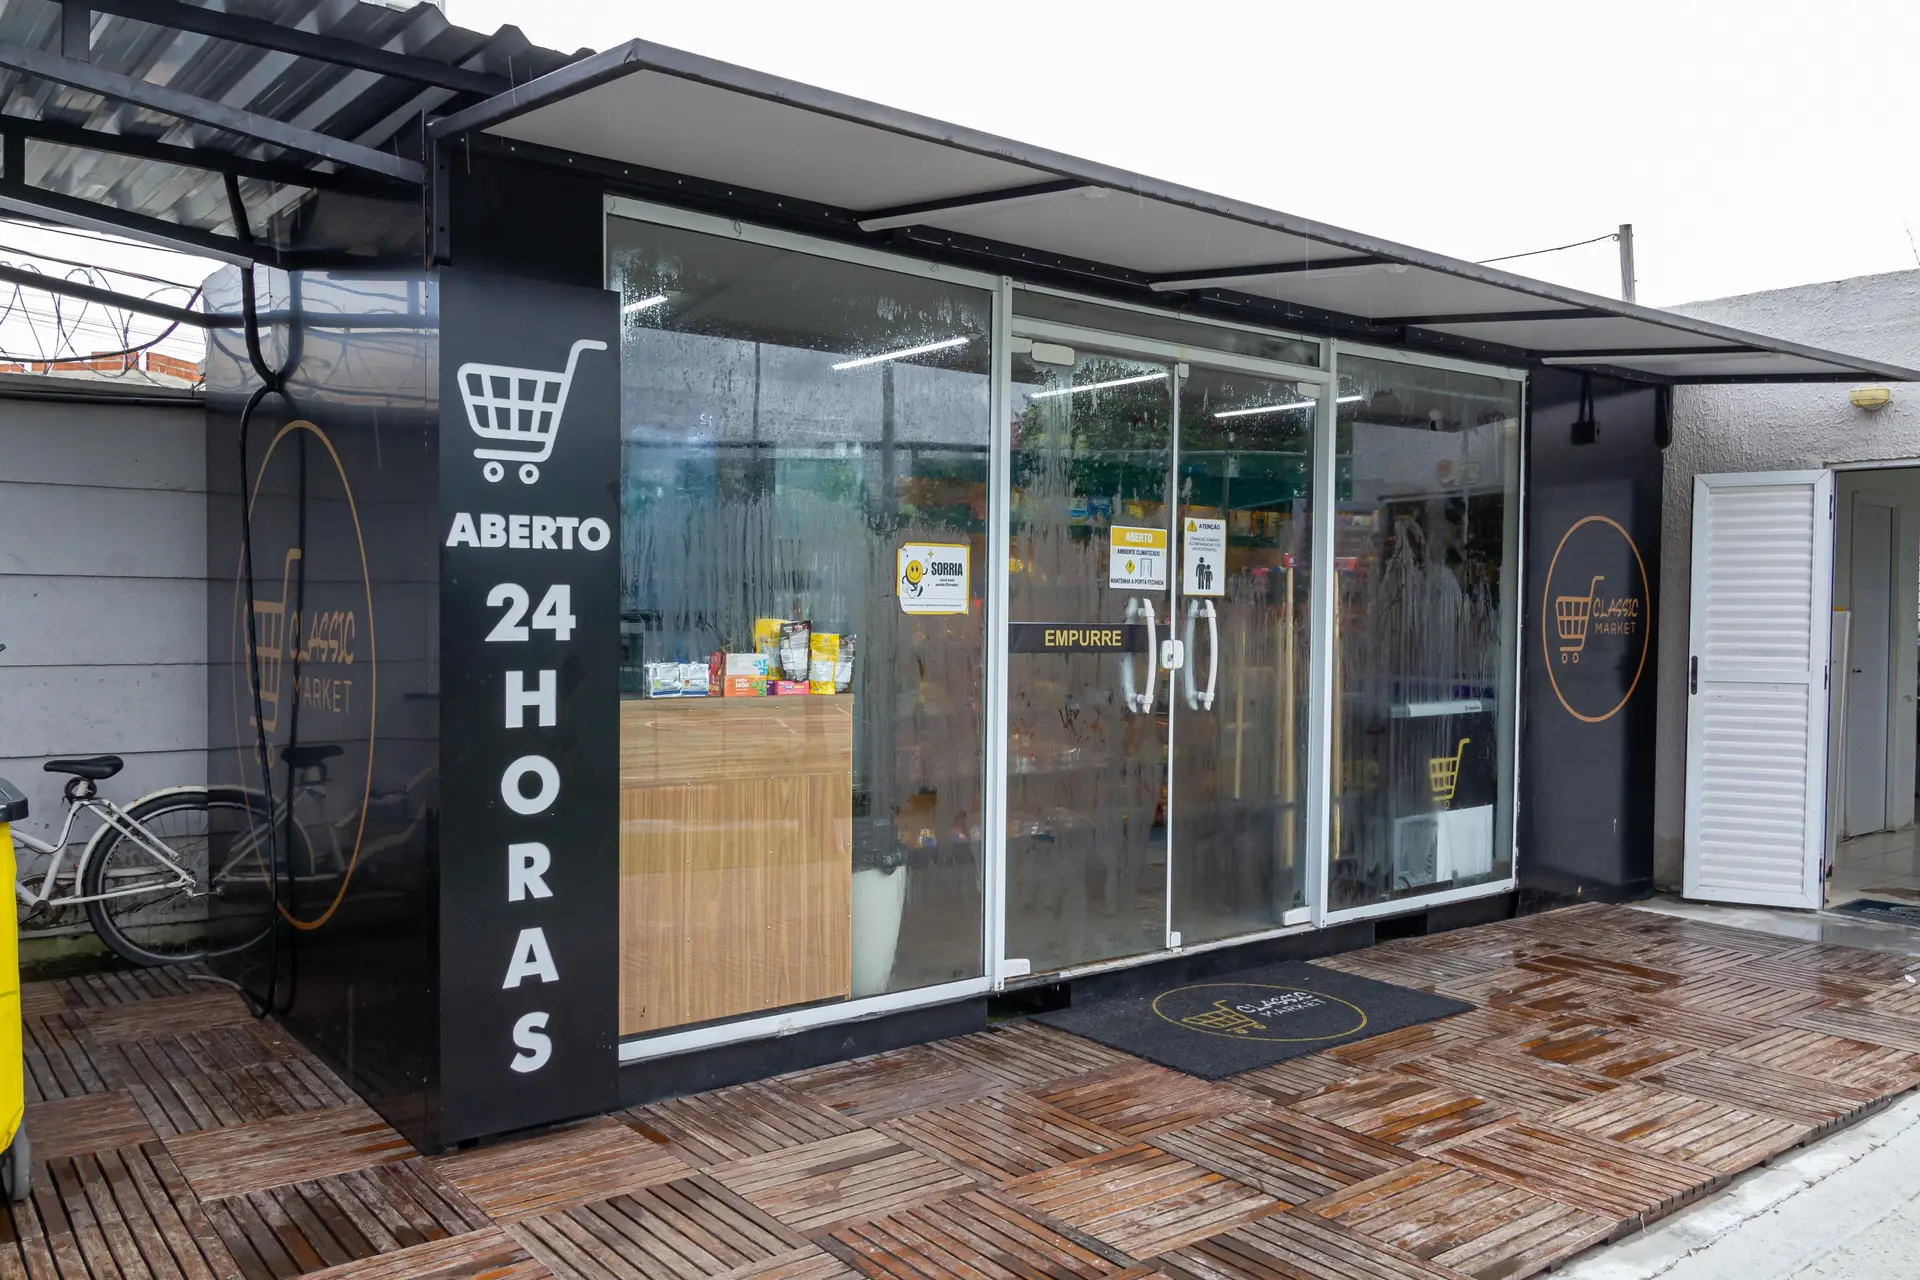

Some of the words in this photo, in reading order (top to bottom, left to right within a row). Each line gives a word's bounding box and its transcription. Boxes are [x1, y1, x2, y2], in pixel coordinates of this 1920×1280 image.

[446, 513, 611, 551] ABERTO
[1198, 522, 1221, 531] ATENÇÃO
[1125, 531, 1154, 543] ABERTO
[1117, 548, 1136, 556] AMBIENTE
[931, 562, 963, 576] SORRIA
[485, 583, 577, 641] 24
[1593, 598, 1639, 618] CLASSIC
[289, 611, 356, 664] CLASSIC
[1595, 621, 1637, 635] MARKET
[1045, 630, 1122, 647] EMPURRE
[292, 674, 353, 715] MARKET
[1236, 992, 1313, 1013] CLASSIC
[1259, 999, 1326, 1018] MARKET
